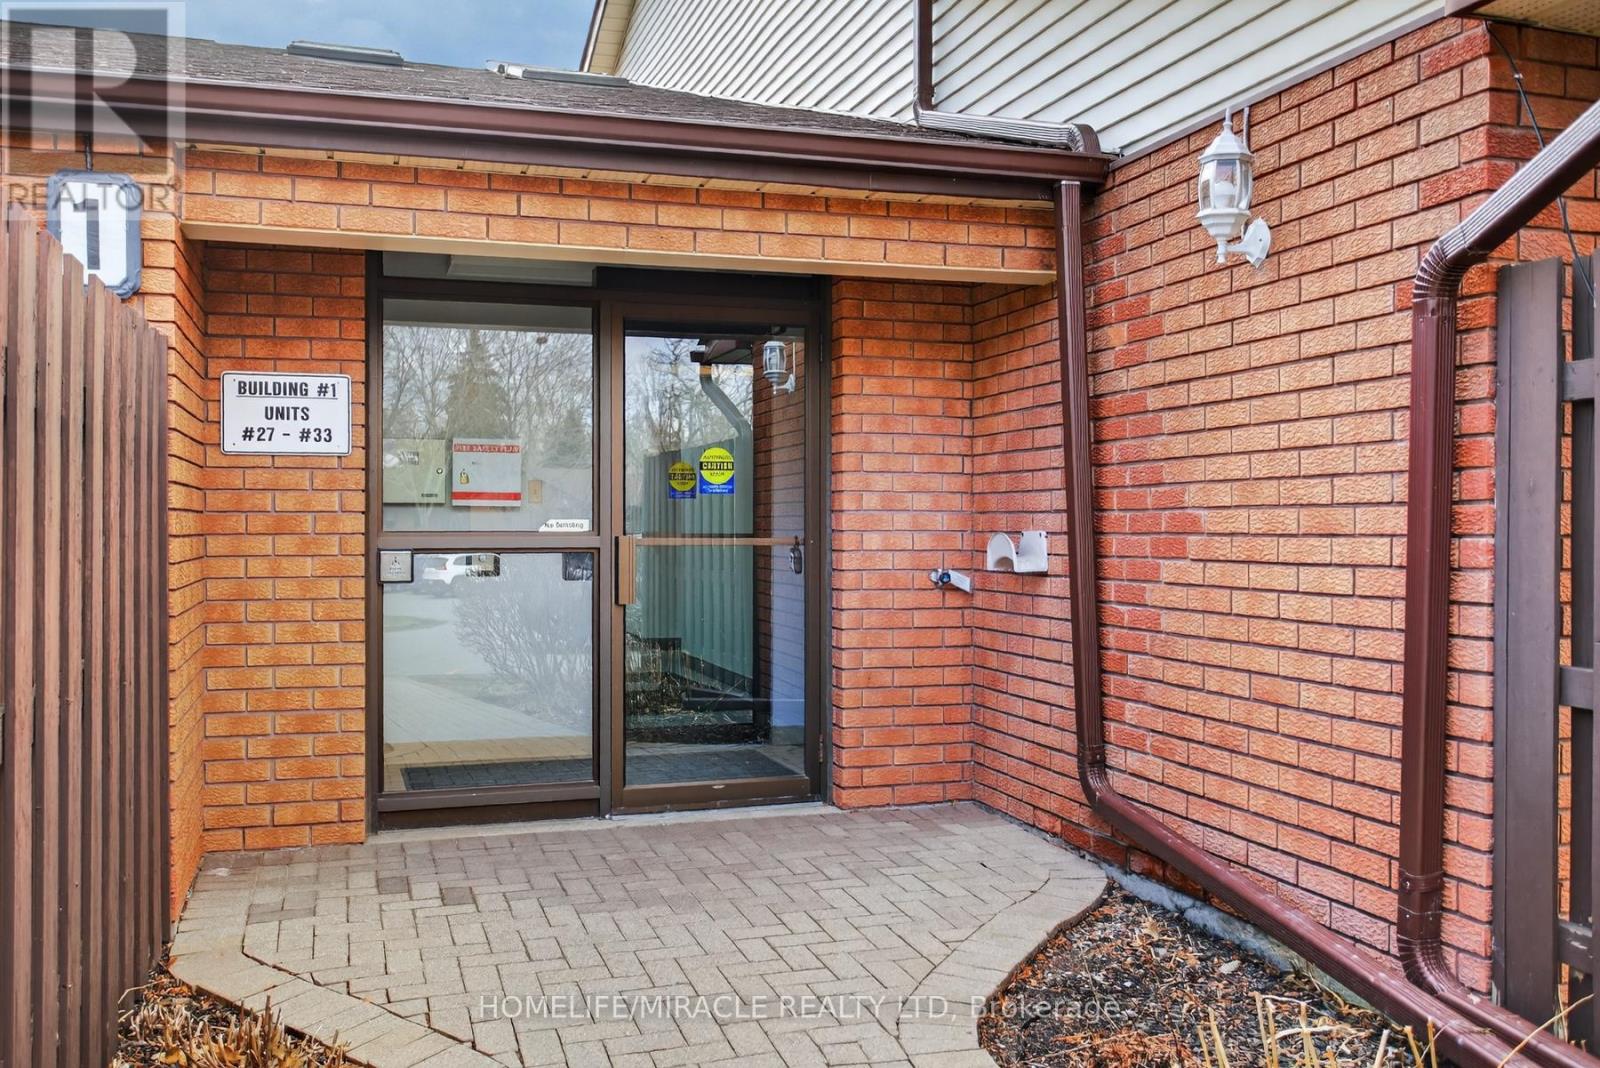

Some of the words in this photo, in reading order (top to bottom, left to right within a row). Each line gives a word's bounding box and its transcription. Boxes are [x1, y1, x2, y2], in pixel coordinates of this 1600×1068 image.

[238, 380, 309, 396] BUILDING
[317, 383, 337, 397] #1
[264, 406, 310, 421] UNITS
[242, 427, 275, 441] #27
[299, 428, 333, 442] #33
